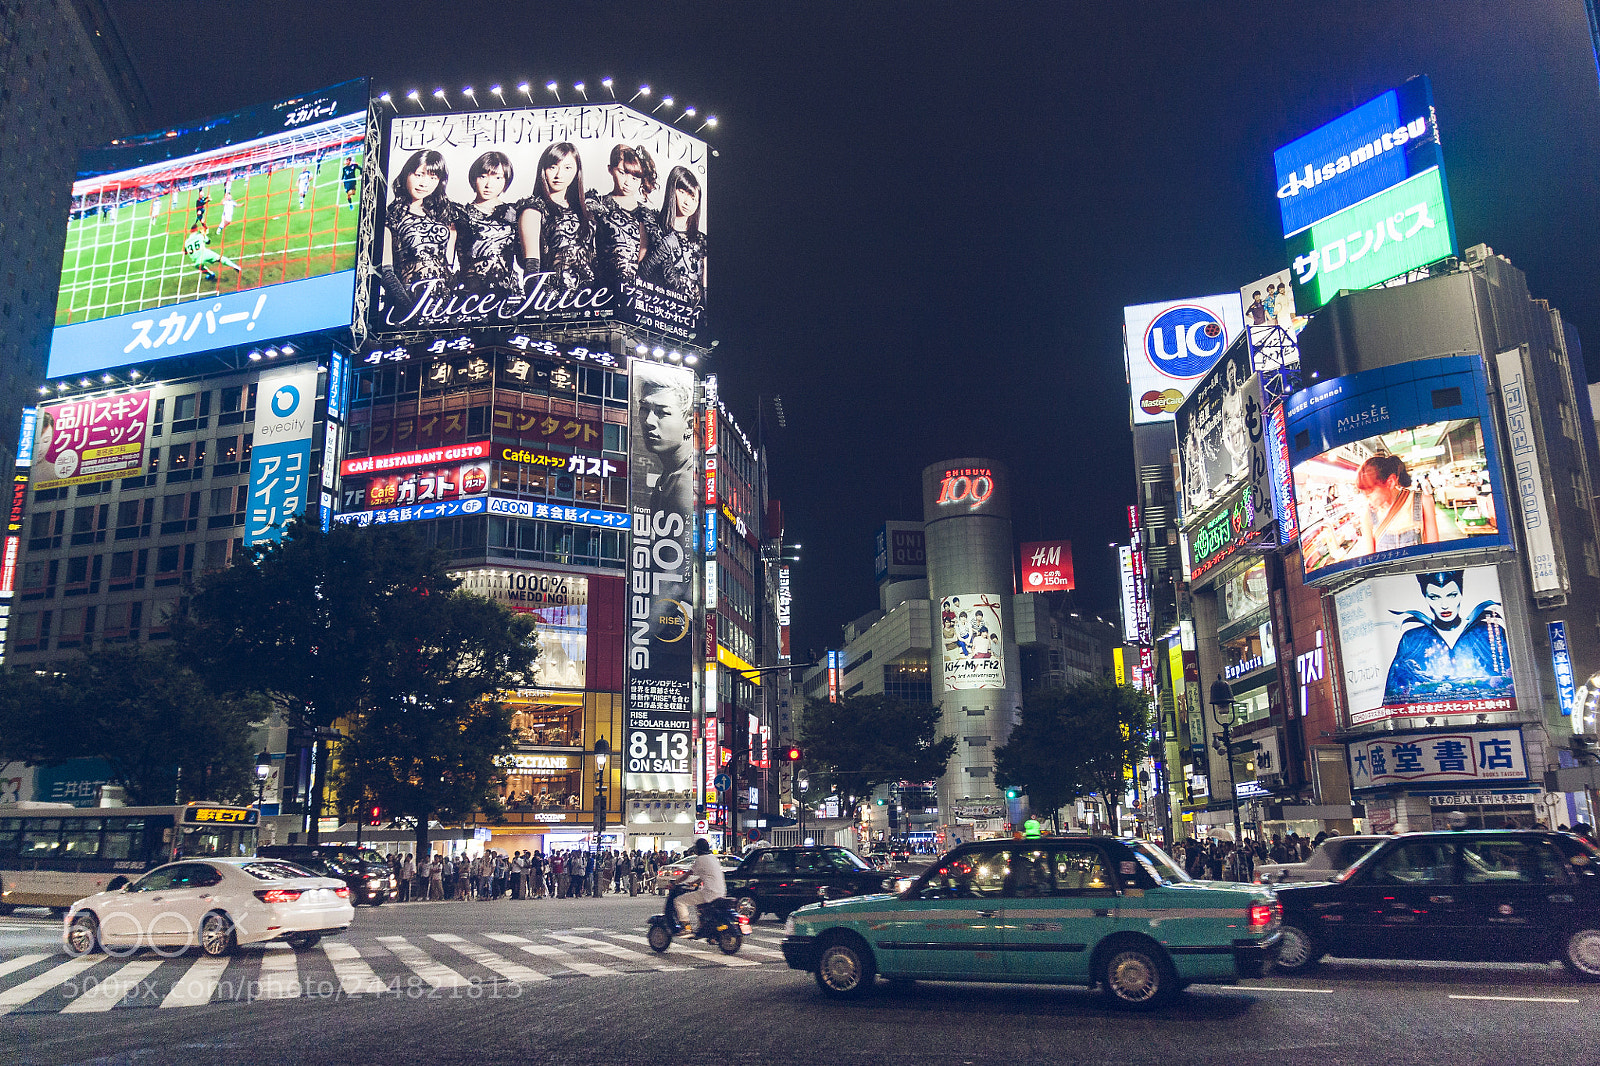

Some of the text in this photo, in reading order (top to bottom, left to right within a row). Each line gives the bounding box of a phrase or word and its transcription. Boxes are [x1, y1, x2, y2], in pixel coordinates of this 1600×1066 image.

[1292, 201, 1435, 285] サロンパス
[665, 290, 688, 303] SINGLE
[428, 336, 473, 353] 月の宴
[508, 335, 559, 356] 月の宴
[567, 347, 616, 366] 月の宴
[1141, 396, 1183, 408] MasterCard
[55, 397, 148, 431] 品川スキン
[54, 418, 145, 453] クリニック
[261, 418, 306, 437] eyecity
[493, 409, 599, 443] コンタクト
[1338, 418, 1390, 434] PLATINUM
[375, 451, 443, 470] RESTAURANT
[444, 444, 483, 460] GUSTO
[1503, 373, 1542, 531] Taisei neon
[567, 455, 618, 478] ガスト
[945, 468, 992, 478] SHIBUYA
[344, 488, 365, 506] 7F
[370, 484, 395, 499] Café
[396, 475, 455, 506] ガスト
[935, 475, 994, 511] 109
[375, 504, 459, 524] 英会話イーオン
[491, 499, 529, 515] AEON
[535, 503, 628, 528] 英会話イーオン
[633, 505, 651, 513] from
[652, 510, 684, 596] SOL
[1031, 545, 1063, 568] H&M
[507, 573, 568, 594] 1000%
[1043, 577, 1068, 586] 150m
[507, 589, 568, 605] WEDDING!
[630, 514, 651, 671] BIGBANG
[659, 615, 680, 625] RISE
[1224, 654, 1263, 680] Euphoria
[630, 711, 649, 719] RISE
[629, 731, 689, 760] 8.13
[629, 759, 689, 773] ON SALE
[1354, 738, 1513, 778] 大盛堂書店
